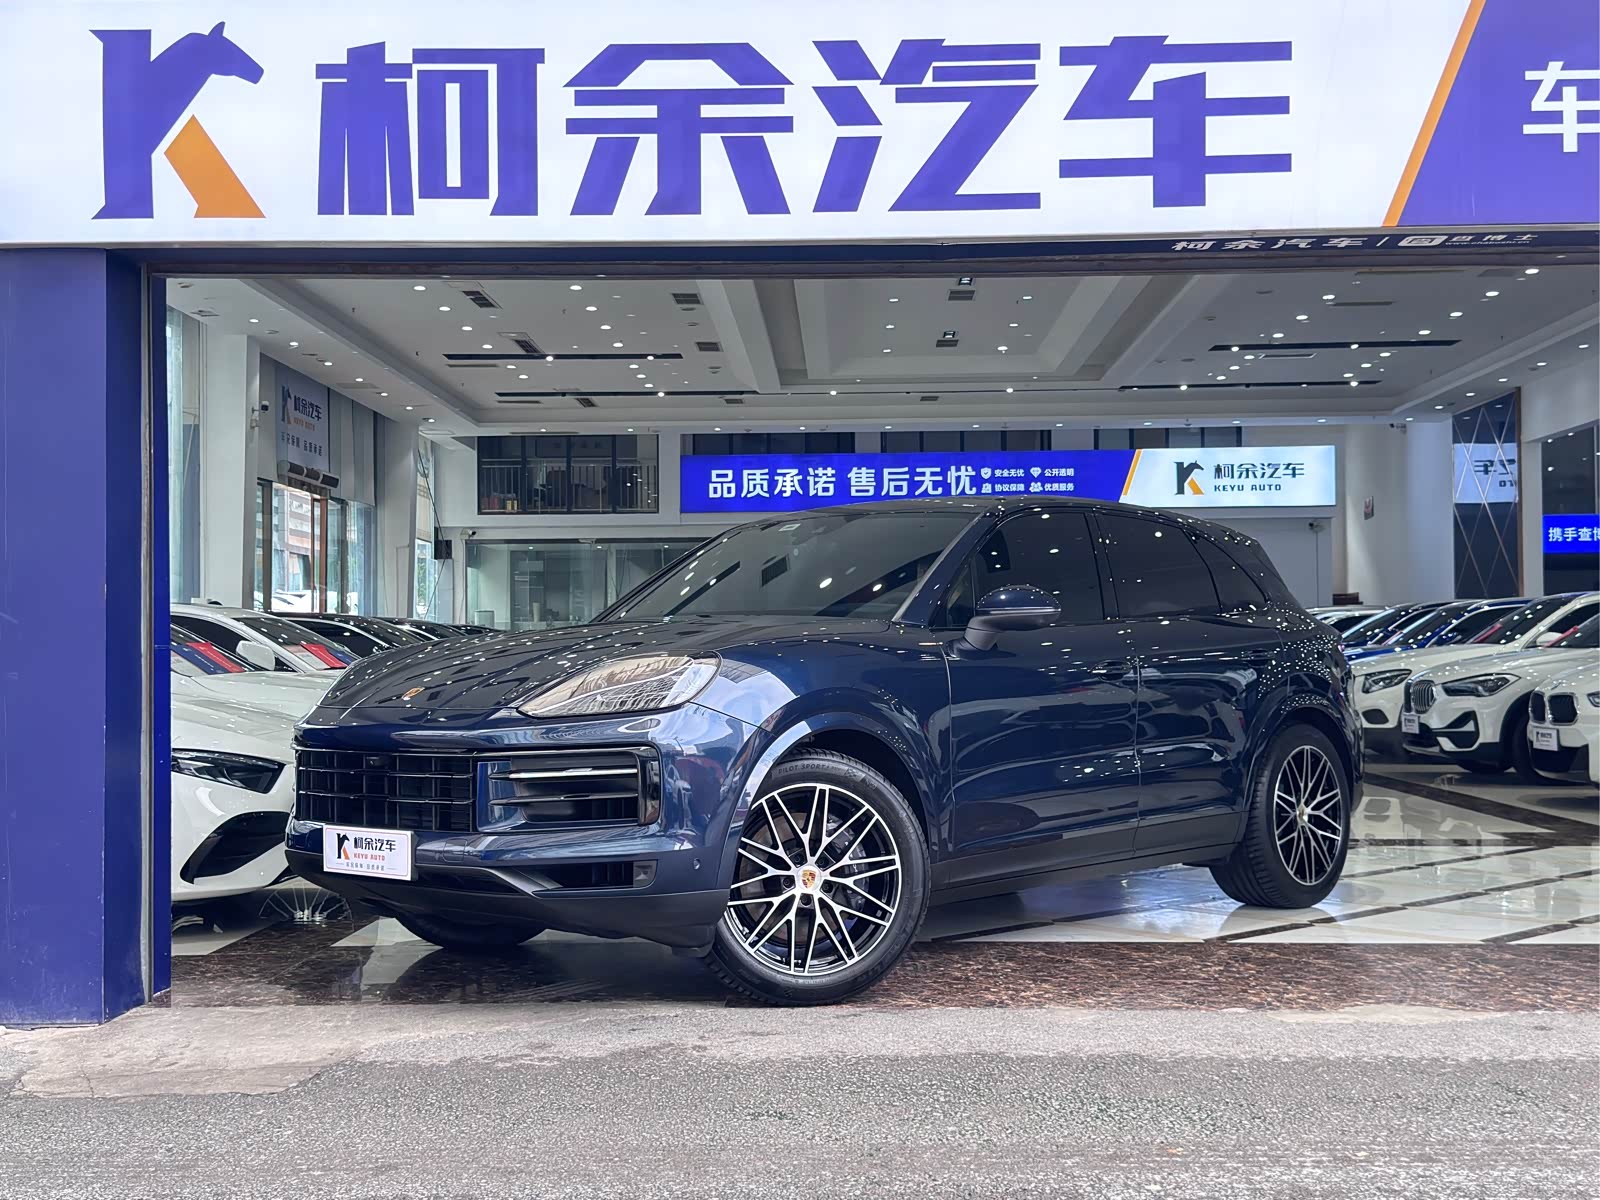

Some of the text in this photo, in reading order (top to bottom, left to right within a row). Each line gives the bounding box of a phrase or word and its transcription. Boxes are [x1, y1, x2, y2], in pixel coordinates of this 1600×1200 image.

[1522, 61, 1600, 152] 车
[316, 35, 1292, 217] 柯余汽车
[1171, 237, 1369, 251] 柯余汽车
[293, 395, 322, 421] 柯余汽车
[1044, 468, 1075, 477] 公开透明
[1213, 463, 1305, 480] 柯余汽车
[708, 465, 977, 498] 品质承诺 售后无忧
[994, 483, 1025, 492] 协议保障
[1044, 482, 1075, 492] 优质服务
[1214, 484, 1245, 492] KEYU
[778, 764, 799, 774] PILOT
[353, 837, 397, 852] 柯余汽车
[353, 852, 368, 860] KEYU
